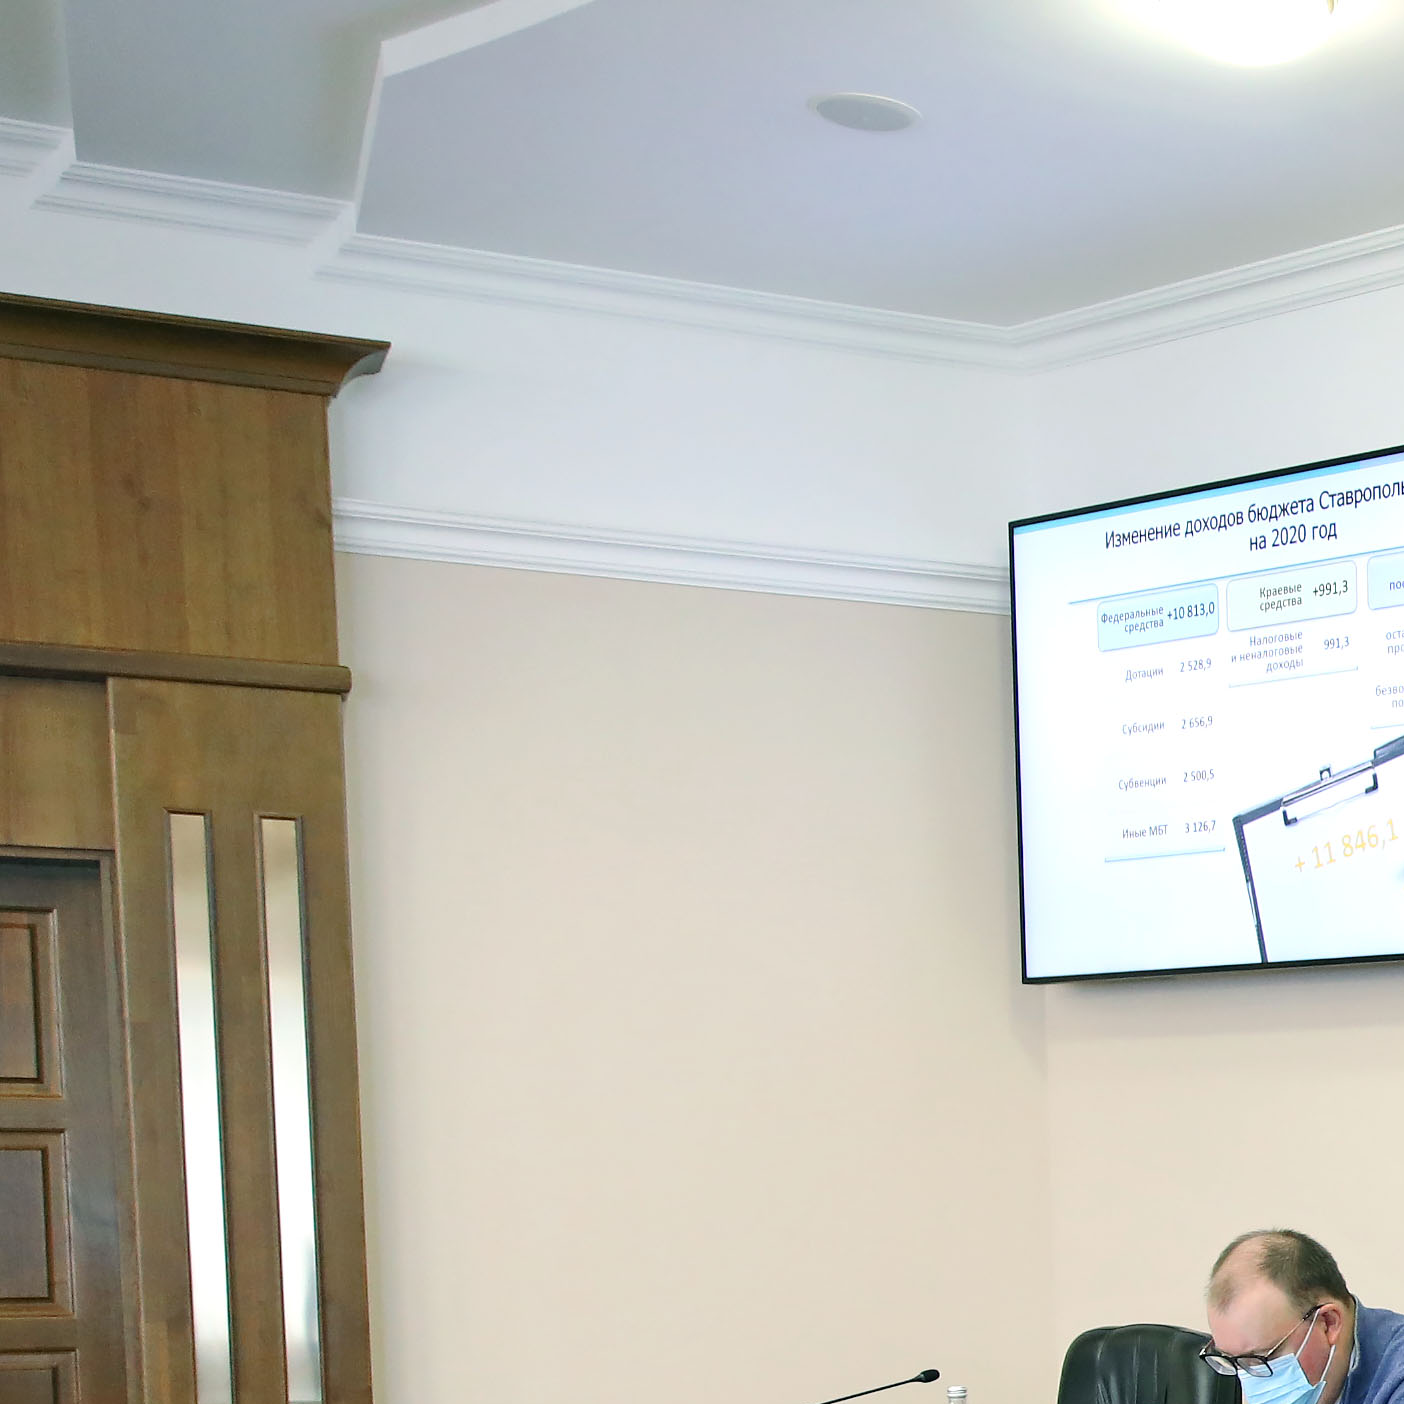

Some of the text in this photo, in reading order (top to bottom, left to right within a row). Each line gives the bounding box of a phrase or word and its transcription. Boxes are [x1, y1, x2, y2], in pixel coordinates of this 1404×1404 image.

[1105, 522, 1181, 549] Изменение
[1184, 511, 1244, 538] доходов
[1248, 497, 1315, 527] бюджета
[1249, 522, 1338, 552] на 2020 год
[1259, 583, 1303, 600] Краевые
[1312, 579, 1349, 598] +991,3
[1167, 601, 1215, 621] +10 813,0
[1259, 597, 1303, 613] средства
[1101, 606, 1165, 624] Федеральные
[1124, 619, 1165, 635] средства
[1249, 631, 1304, 648] Налоговые
[1323, 636, 1350, 651] 991,3
[1231, 644, 1304, 663] и неналоговые
[1187, 657, 1212, 672] 528,9
[1265, 658, 1304, 673] доходы
[1125, 667, 1164, 683] Дотации
[1122, 721, 1165, 736] Субсидии
[1189, 715, 1213, 729] 656,9
[1190, 769, 1215, 782] 500,5
[1118, 777, 1167, 792] Субвенции
[1122, 824, 1168, 840] Иные МБТ
[1193, 820, 1216, 833] 126,7
[1312, 845, 1336, 869] 11
[1342, 818, 1399, 857] 846,1
